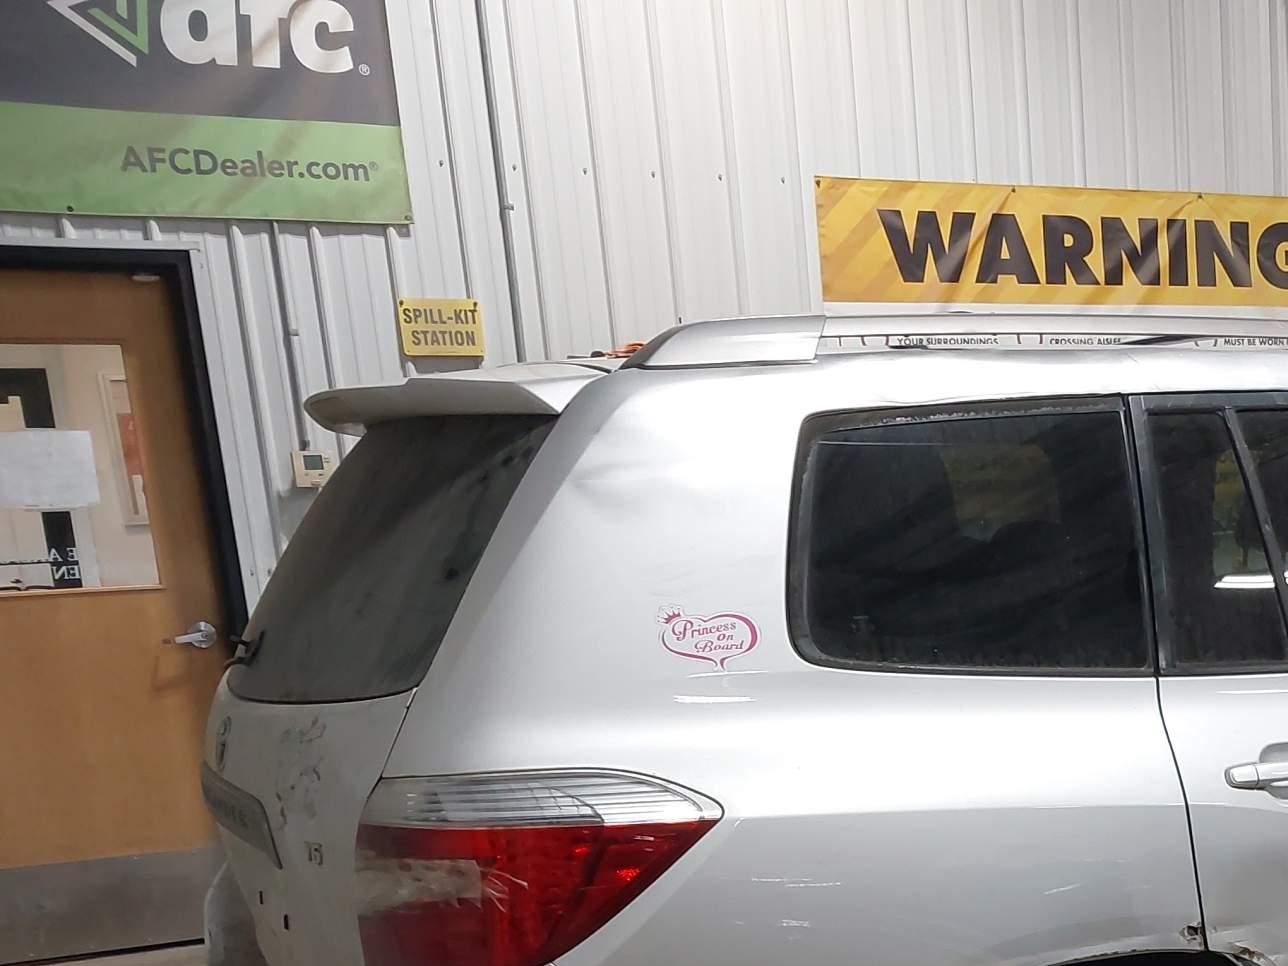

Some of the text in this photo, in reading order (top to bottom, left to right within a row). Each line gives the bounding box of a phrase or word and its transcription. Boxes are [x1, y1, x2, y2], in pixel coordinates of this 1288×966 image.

[402, 307, 478, 325] SPILL-KIT
[411, 329, 477, 347] STATION
[896, 337, 924, 346] YOUR
[1223, 338, 1245, 347] MUST
[1247, 338, 1257, 347] BE
[671, 619, 738, 642] Princess
[694, 639, 745, 653] Board
